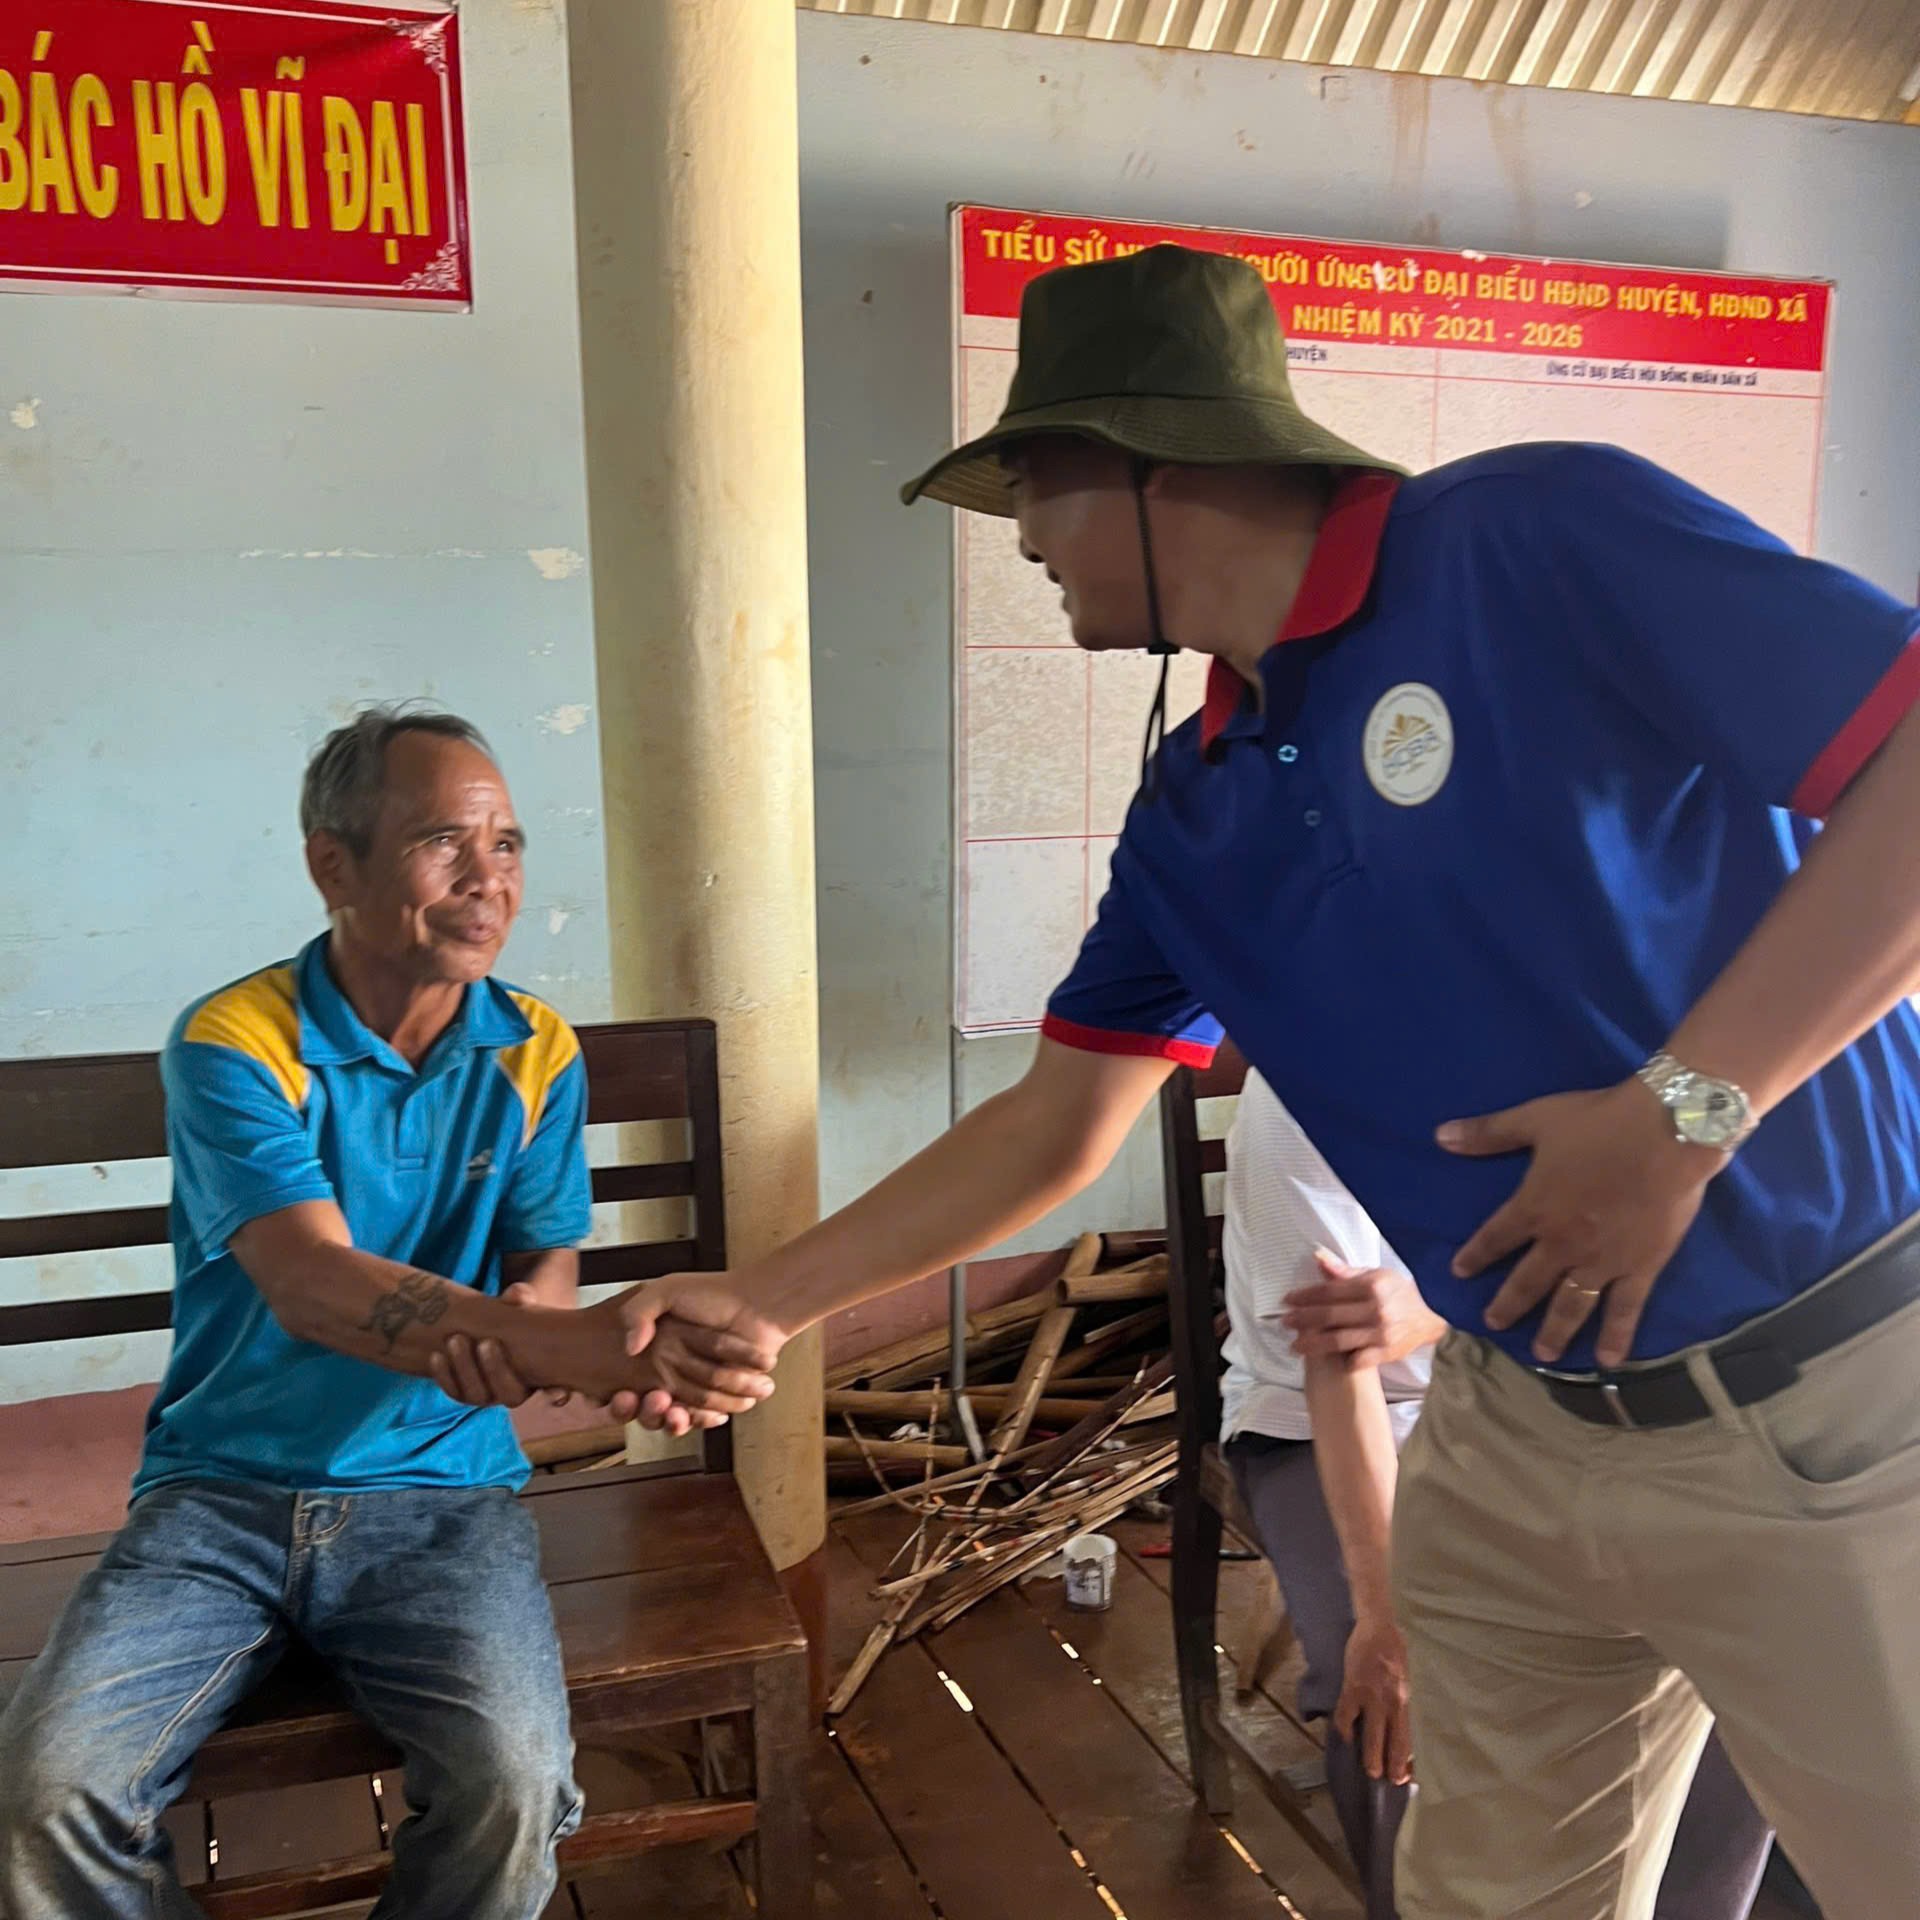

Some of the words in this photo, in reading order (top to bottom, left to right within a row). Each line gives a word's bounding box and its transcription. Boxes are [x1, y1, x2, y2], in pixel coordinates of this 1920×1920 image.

[0, 31, 119, 218] BÁC
[132, 21, 226, 225] HỒ
[240, 56, 310, 228] VĨ
[323, 96, 430, 264] ĐẠI
[981, 219, 1055, 263] TIỂU
[1064, 229, 1108, 265] SỬ
[1225, 251, 1309, 285] ƯỜI
[1317, 254, 1373, 289] ỨNG
[1424, 269, 1470, 301] ĐẠI
[1476, 264, 1537, 303] BIỂU
[1543, 280, 1611, 308] HĐND
[1616, 283, 1703, 319] HUYỆN,
[1293, 302, 1382, 338] NHIỆM
[1434, 314, 1497, 343] 2021
[1521, 321, 1583, 348] 2026
